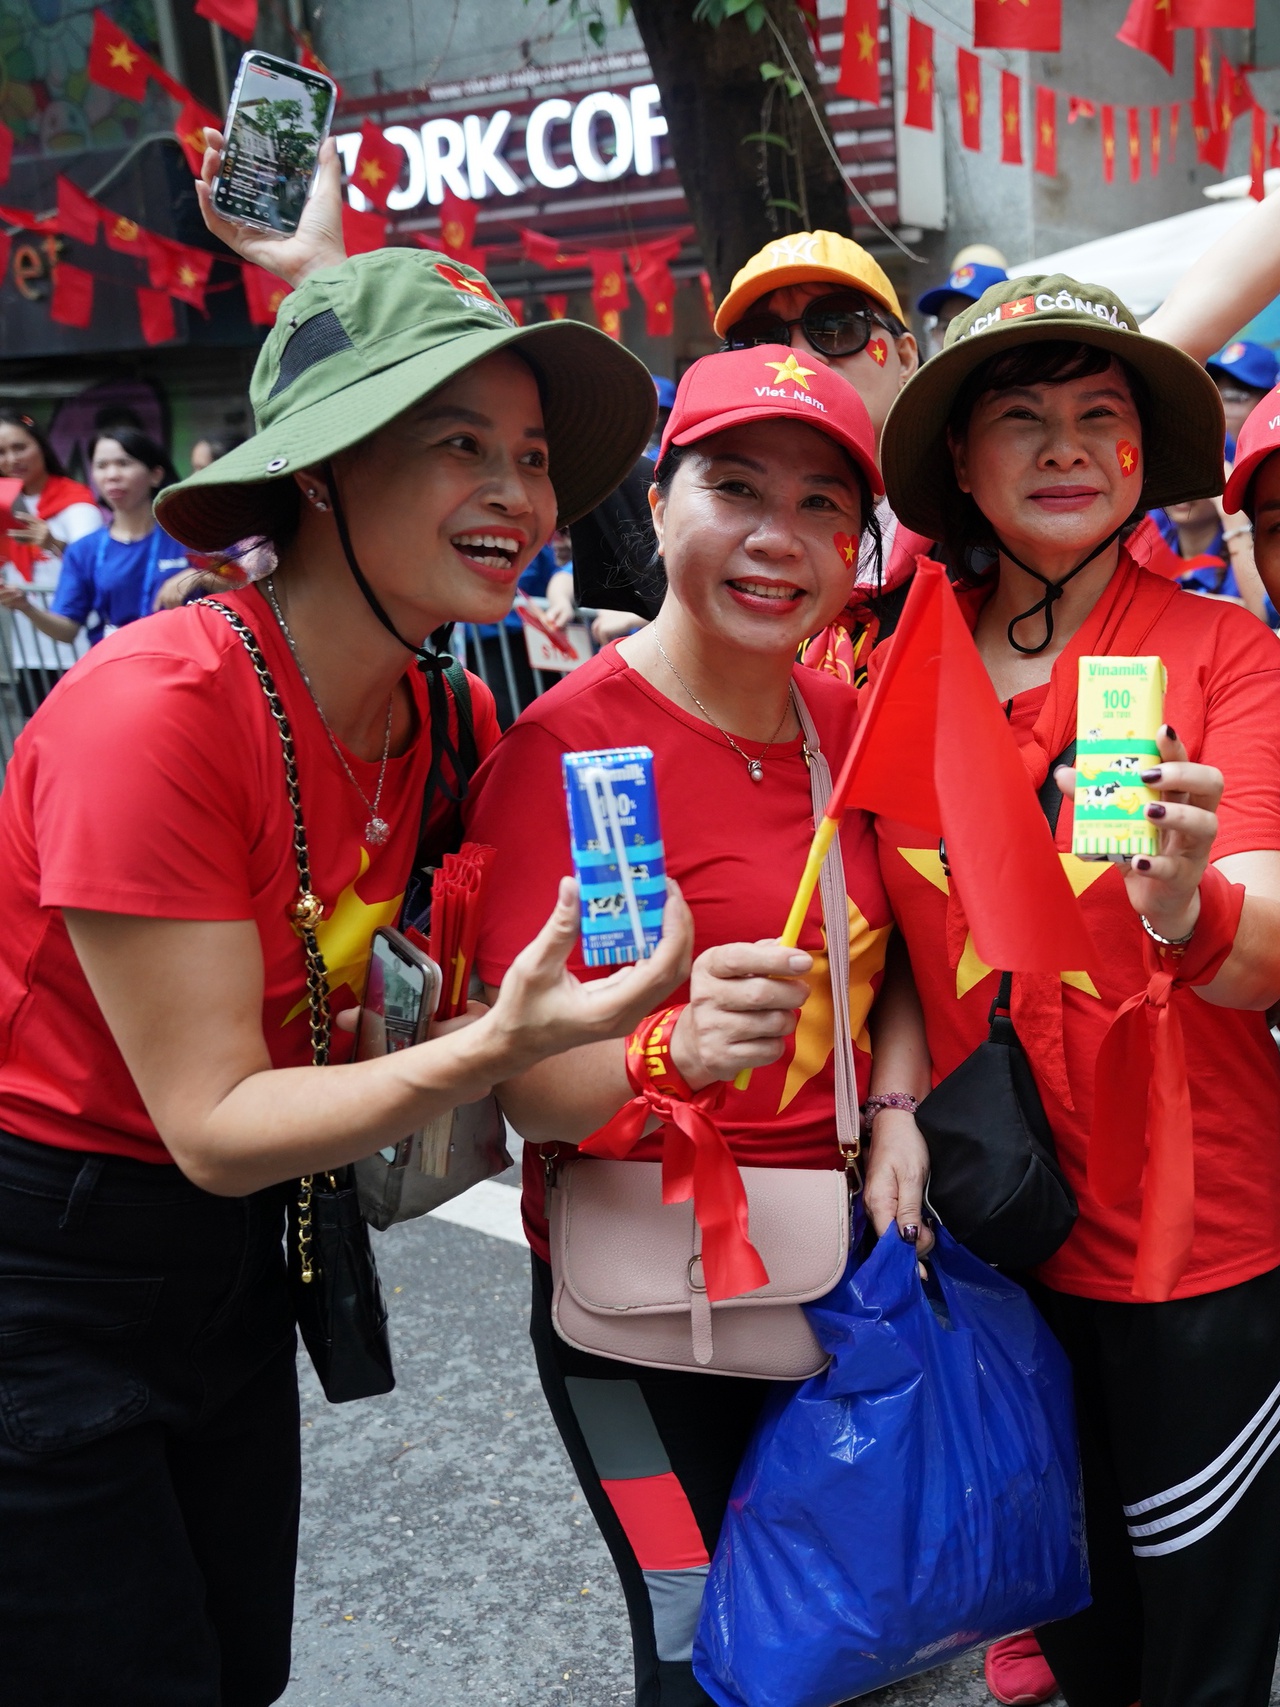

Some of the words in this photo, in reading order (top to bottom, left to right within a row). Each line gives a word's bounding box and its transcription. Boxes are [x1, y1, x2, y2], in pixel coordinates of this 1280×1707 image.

[336, 109, 524, 213] ORK
[1036, 290, 1093, 314] CÔN
[755, 386, 786, 398] Viet
[793, 389, 826, 412] Nam
[1089, 662, 1147, 676] Vinamilk
